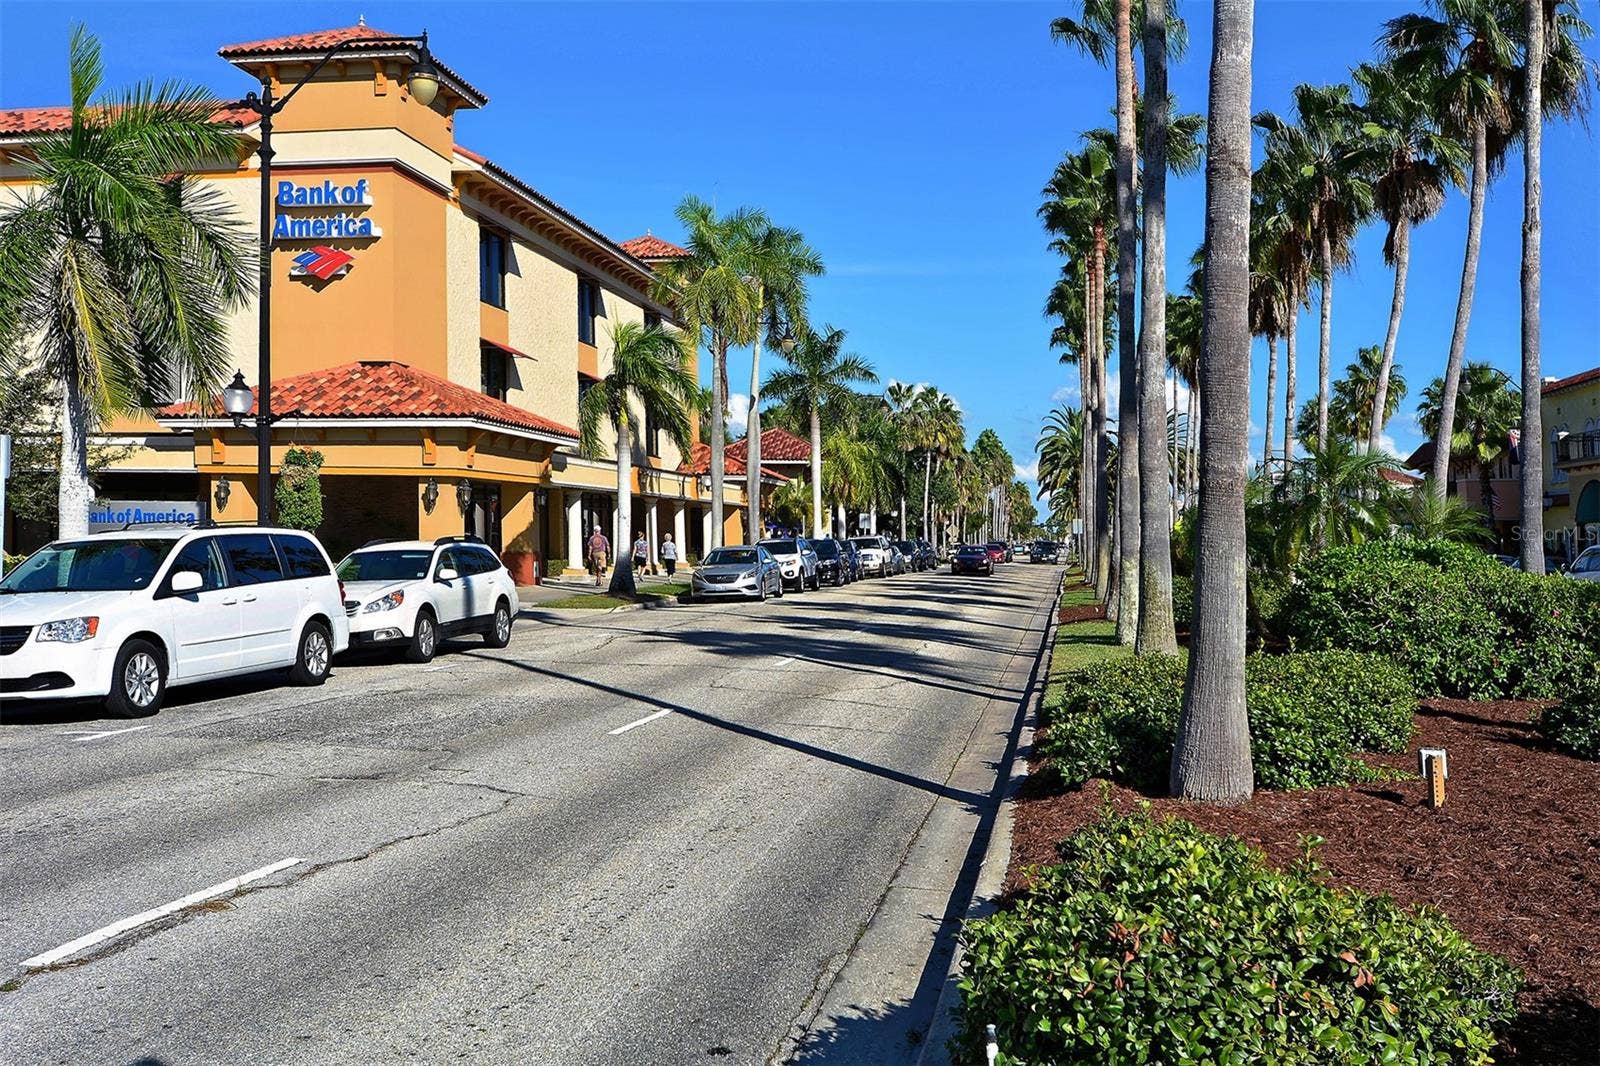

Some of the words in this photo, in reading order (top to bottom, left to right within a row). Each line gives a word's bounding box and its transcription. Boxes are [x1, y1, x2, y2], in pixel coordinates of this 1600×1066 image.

[278, 180, 339, 206] Bank
[341, 179, 368, 205] of
[274, 212, 373, 238] America
[89, 507, 115, 523] ank
[116, 508, 132, 523] of
[133, 508, 196, 524] America
